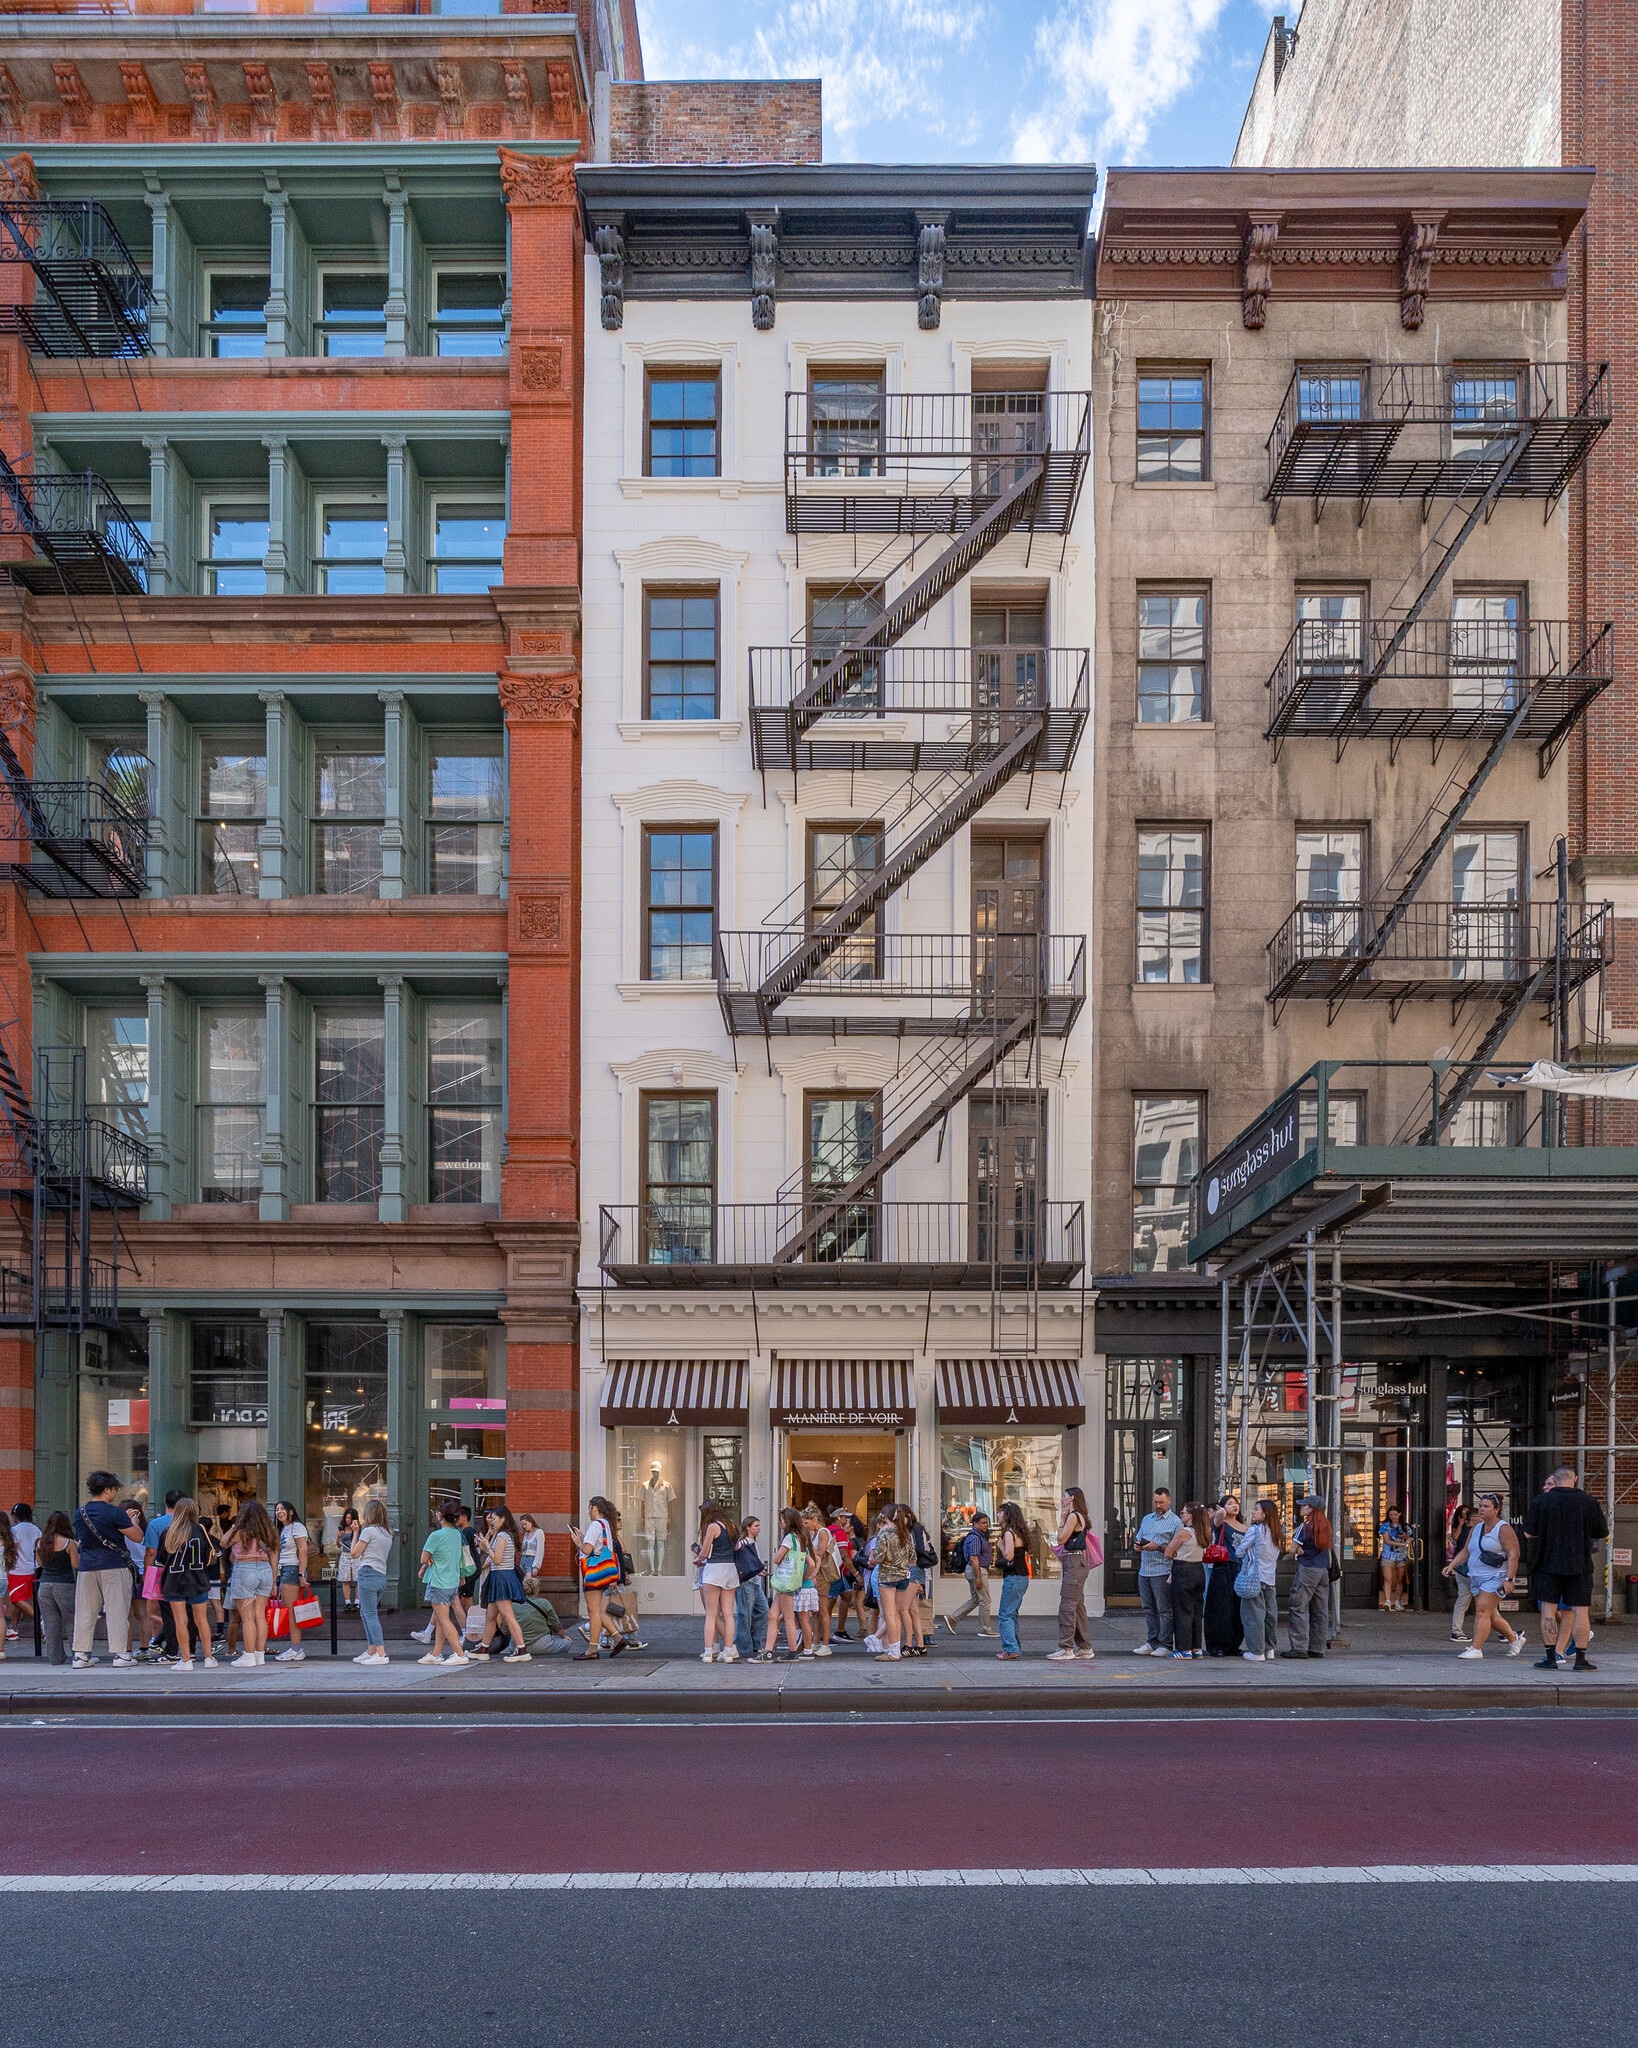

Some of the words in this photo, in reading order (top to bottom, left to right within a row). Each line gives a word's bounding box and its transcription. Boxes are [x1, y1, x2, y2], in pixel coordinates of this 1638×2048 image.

[1221, 1143, 1269, 1197] sunglass
[1270, 1115, 1294, 1156] hut
[1357, 1382, 1406, 1397] sunglass
[1408, 1382, 1428, 1394] hut
[787, 1409, 845, 1424] MANIÈRE
[848, 1412, 864, 1424] DE
[868, 1412, 900, 1424] VOIR
[709, 1486, 734, 1500] 521
